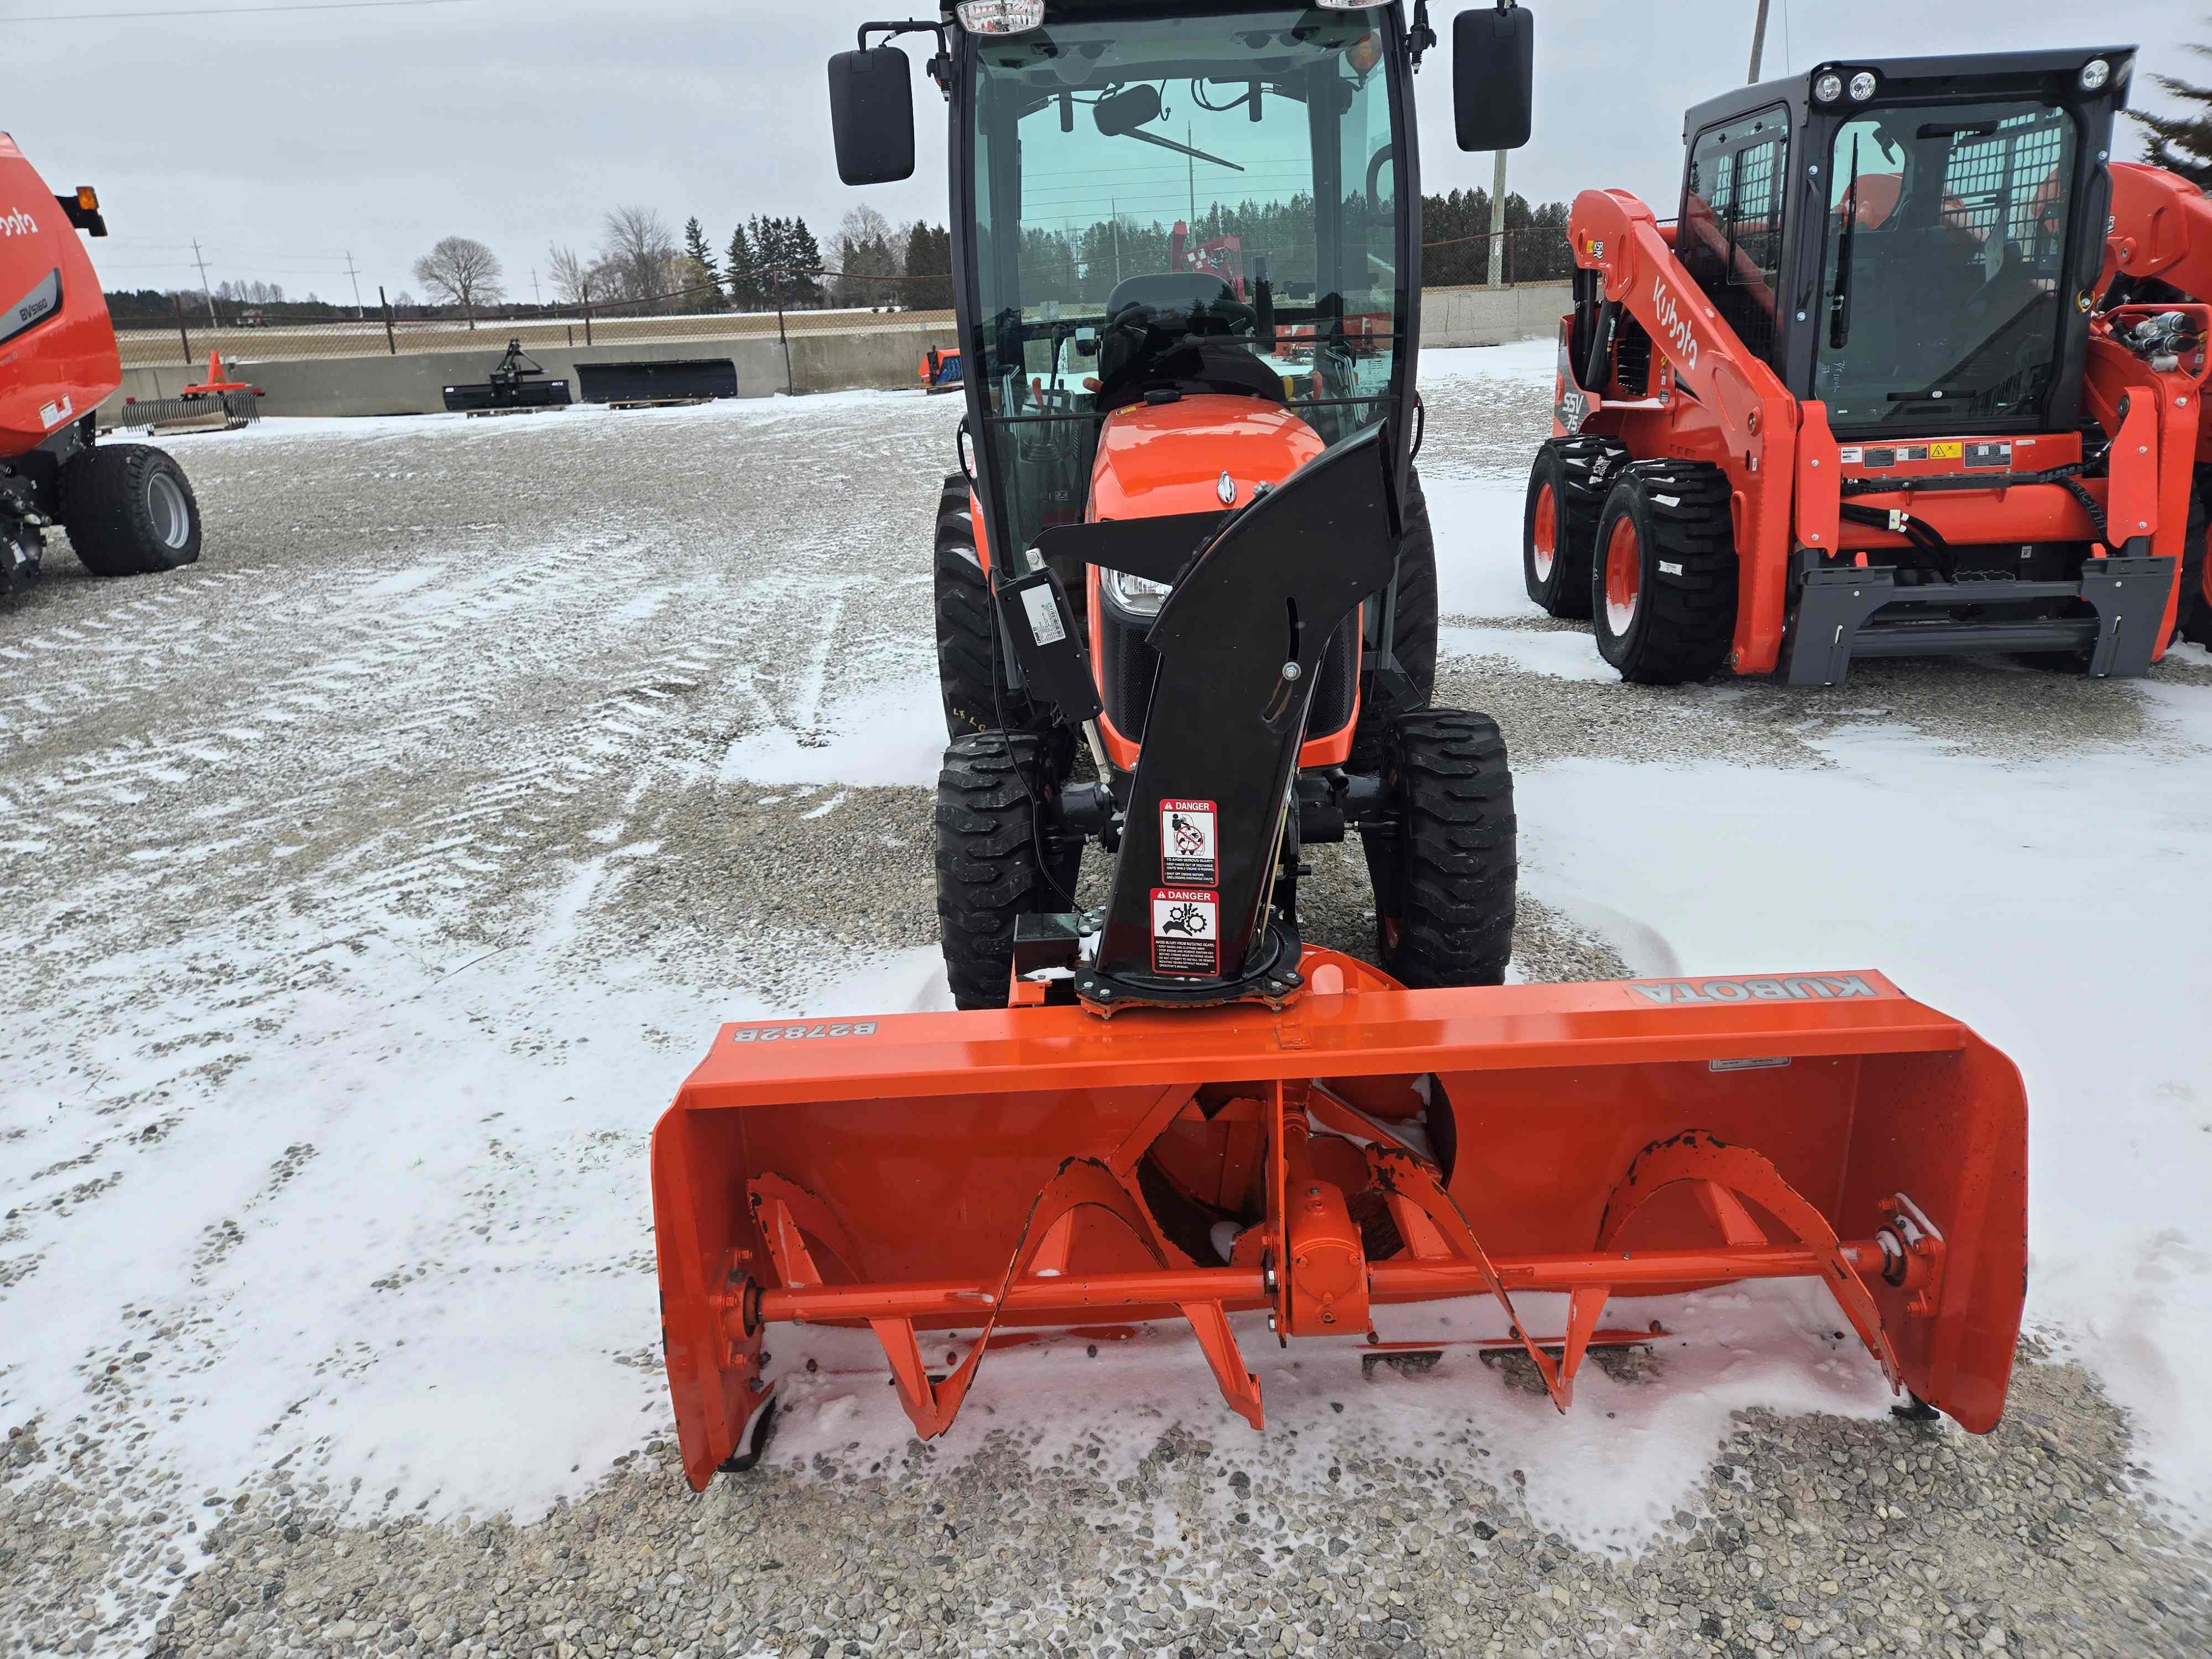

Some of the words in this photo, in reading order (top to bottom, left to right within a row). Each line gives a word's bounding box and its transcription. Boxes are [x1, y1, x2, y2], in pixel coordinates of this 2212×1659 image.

[19, 298, 48, 322] BV5160
[1653, 275, 1697, 371] Kubota
[1562, 392, 1584, 414] SSV
[1567, 414, 1579, 431] 75
[1175, 802, 1209, 811] DANGER
[1168, 891, 1211, 901] DANGER
[1630, 975, 1876, 1004] KUBOTA
[734, 1022, 879, 1042] B2782B
